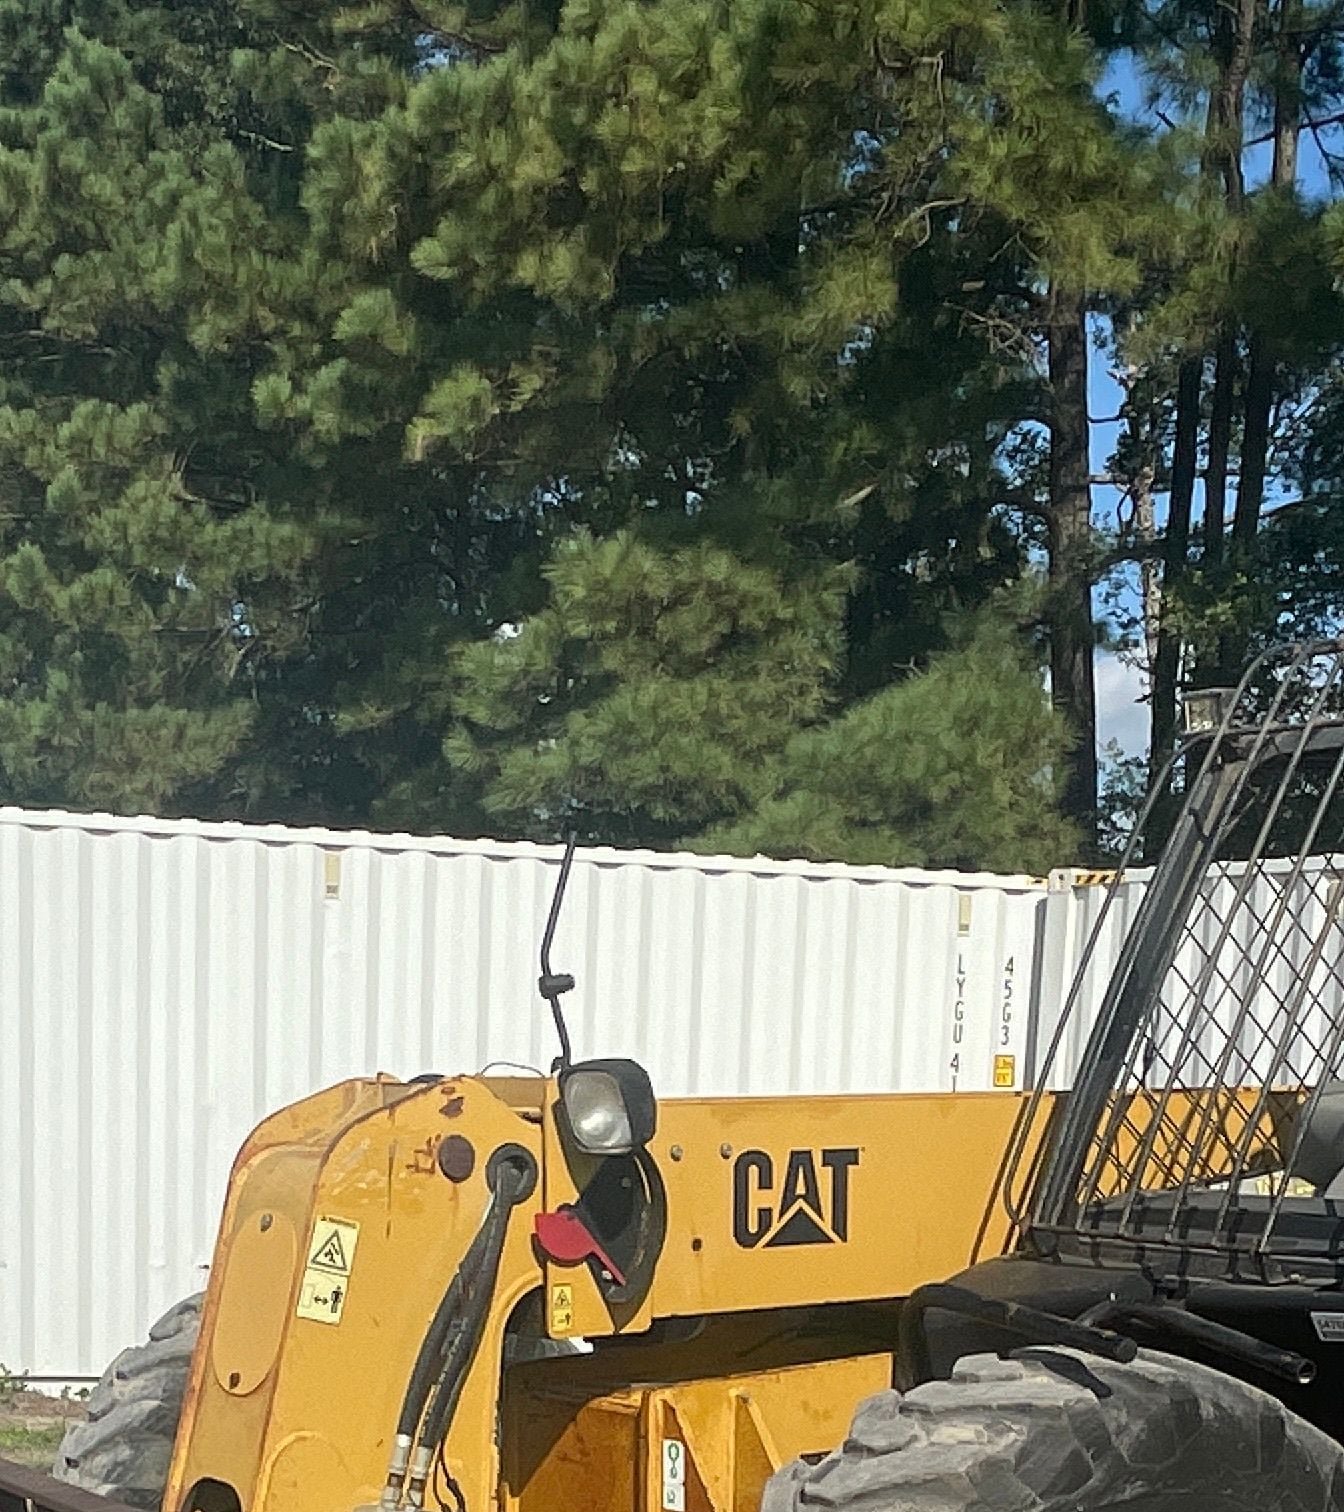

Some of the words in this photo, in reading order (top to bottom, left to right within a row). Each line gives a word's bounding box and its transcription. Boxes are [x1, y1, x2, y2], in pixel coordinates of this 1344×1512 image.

[952, 953, 965, 1044] LYGU
[1001, 955, 1014, 1045] 45G3
[733, 1148, 860, 1249] CAT
